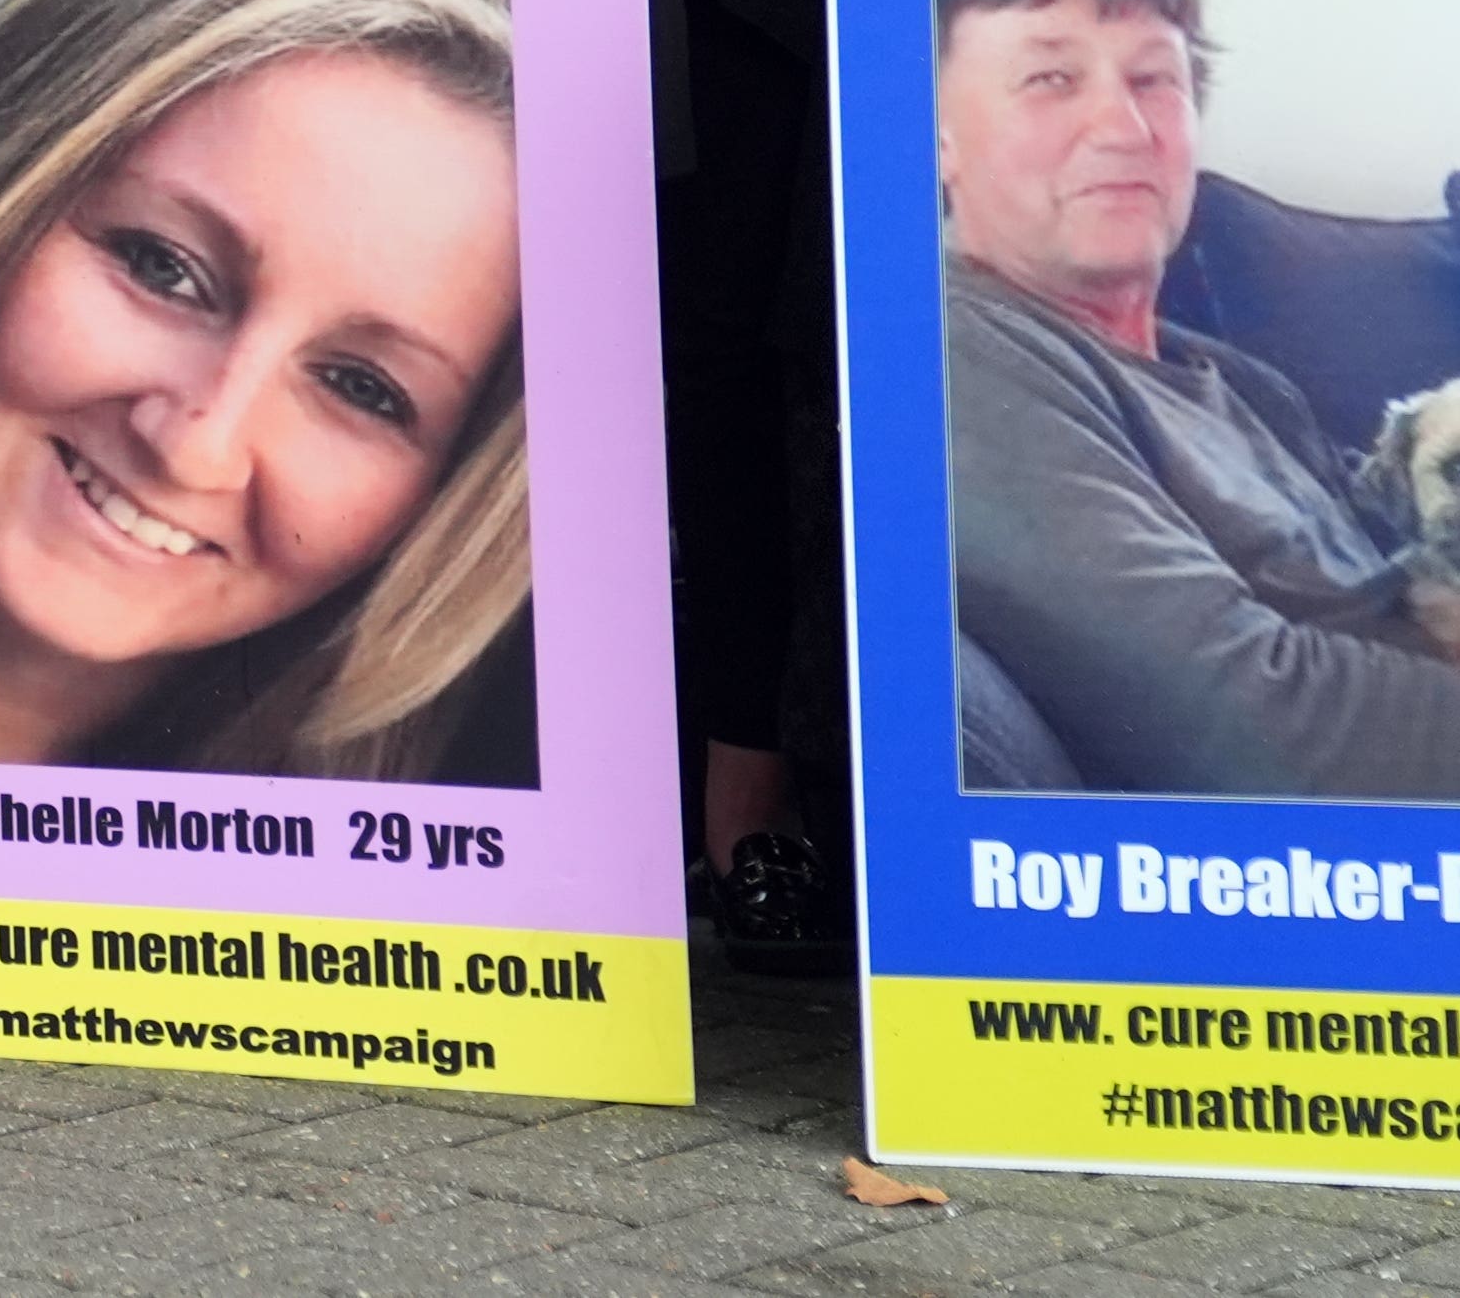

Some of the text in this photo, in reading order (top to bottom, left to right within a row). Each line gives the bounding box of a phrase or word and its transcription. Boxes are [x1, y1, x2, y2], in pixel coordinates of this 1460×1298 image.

[136, 800, 314, 858] Morton
[349, 810, 412, 863] 29
[423, 823, 505, 870] yrs
